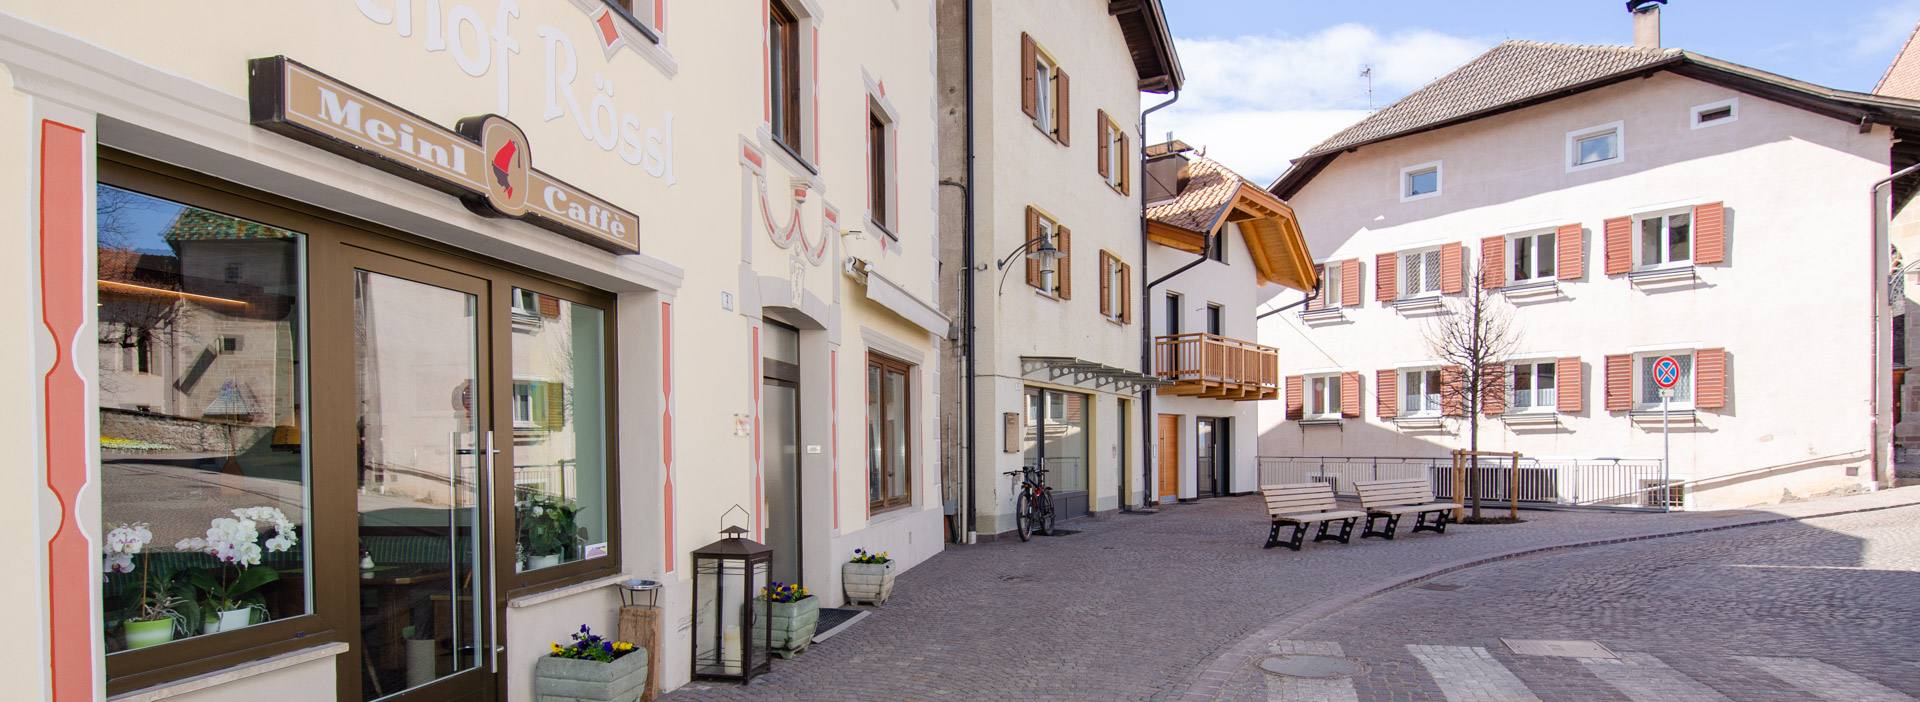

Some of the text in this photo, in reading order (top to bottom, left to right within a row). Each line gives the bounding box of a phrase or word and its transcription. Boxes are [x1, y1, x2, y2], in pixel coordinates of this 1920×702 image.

[317, 85, 625, 239] Meinl Caffè
[537, 24, 677, 188] Rössl
